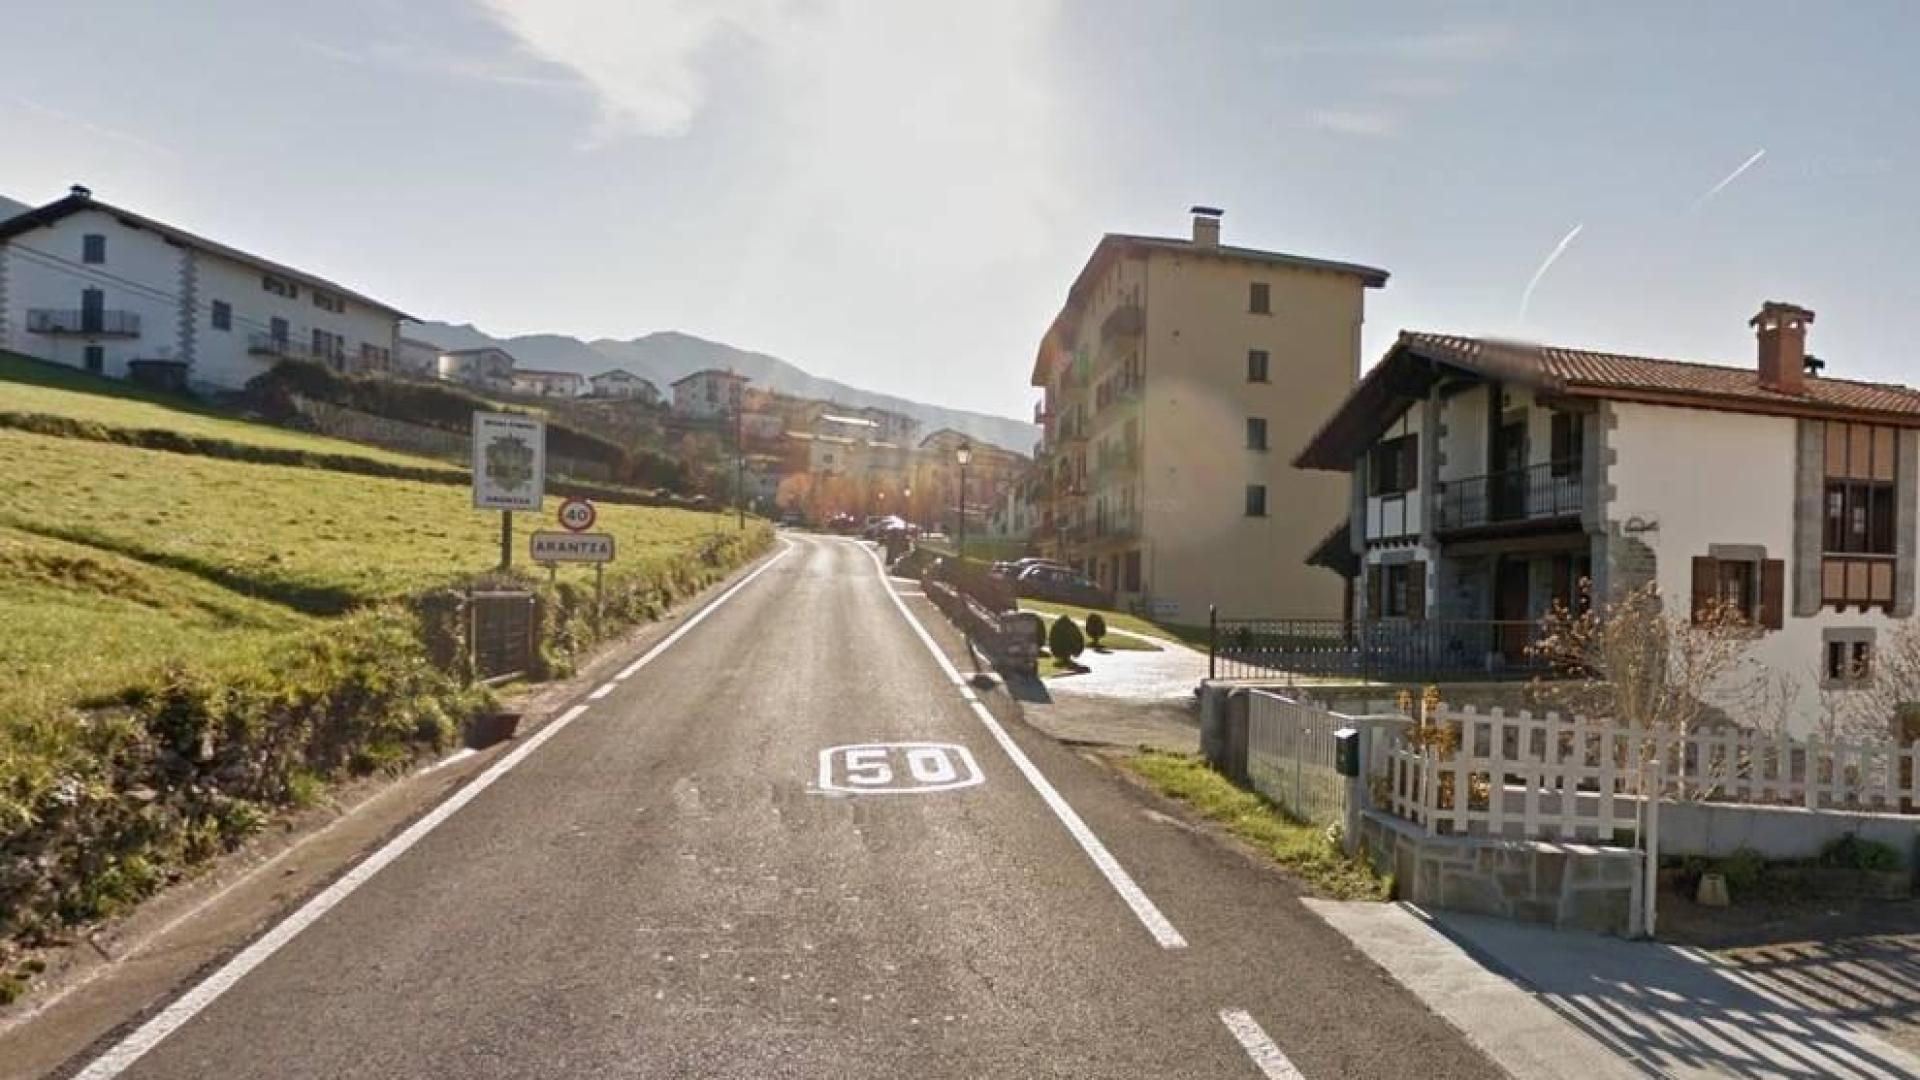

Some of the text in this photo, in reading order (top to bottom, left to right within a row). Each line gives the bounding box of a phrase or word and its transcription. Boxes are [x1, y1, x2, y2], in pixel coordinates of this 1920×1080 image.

[565, 508, 586, 521] 40
[535, 541, 608, 554] ARANTZA
[845, 748, 956, 784] 50
